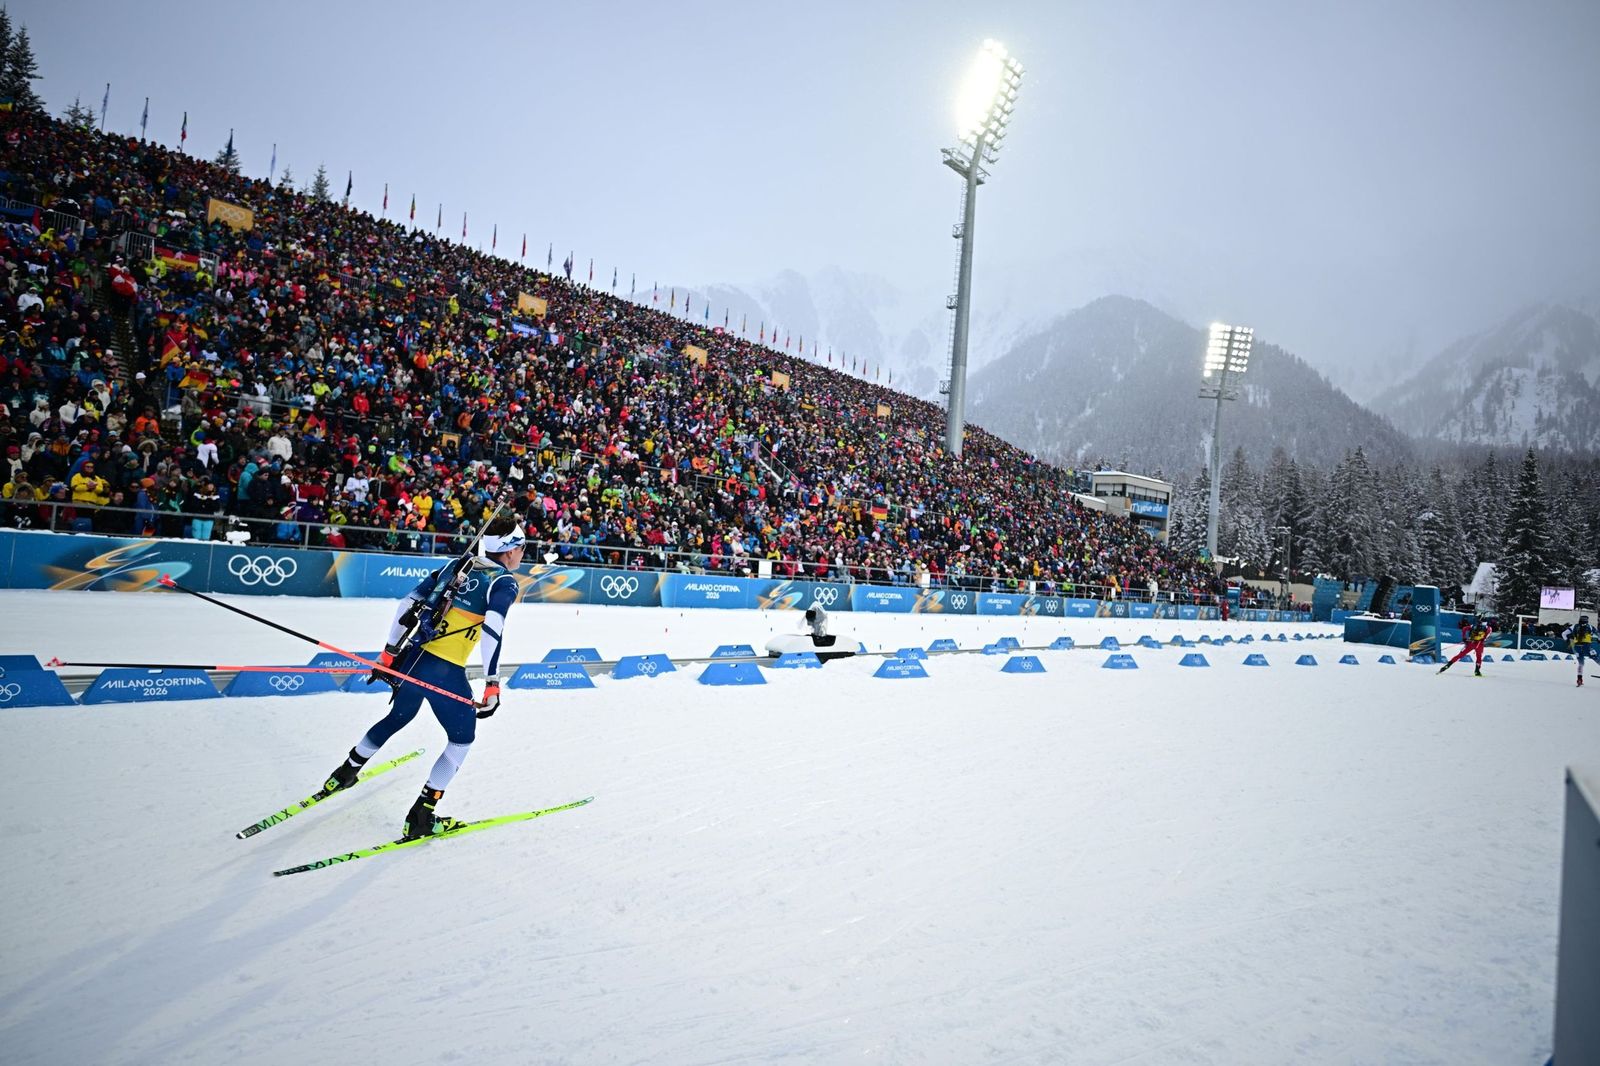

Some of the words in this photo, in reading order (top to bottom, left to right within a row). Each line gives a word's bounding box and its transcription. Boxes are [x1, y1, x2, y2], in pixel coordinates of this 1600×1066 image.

[380, 566, 430, 578] MILANO
[684, 582, 713, 592] MILANO
[714, 584, 741, 593] CORTINA
[705, 592, 720, 600] 2026
[520, 672, 552, 680] MILANO
[553, 672, 586, 680] CORTINA
[100, 679, 154, 690] MILANO
[155, 677, 207, 688] CORTINA
[143, 687, 169, 697] 2026
